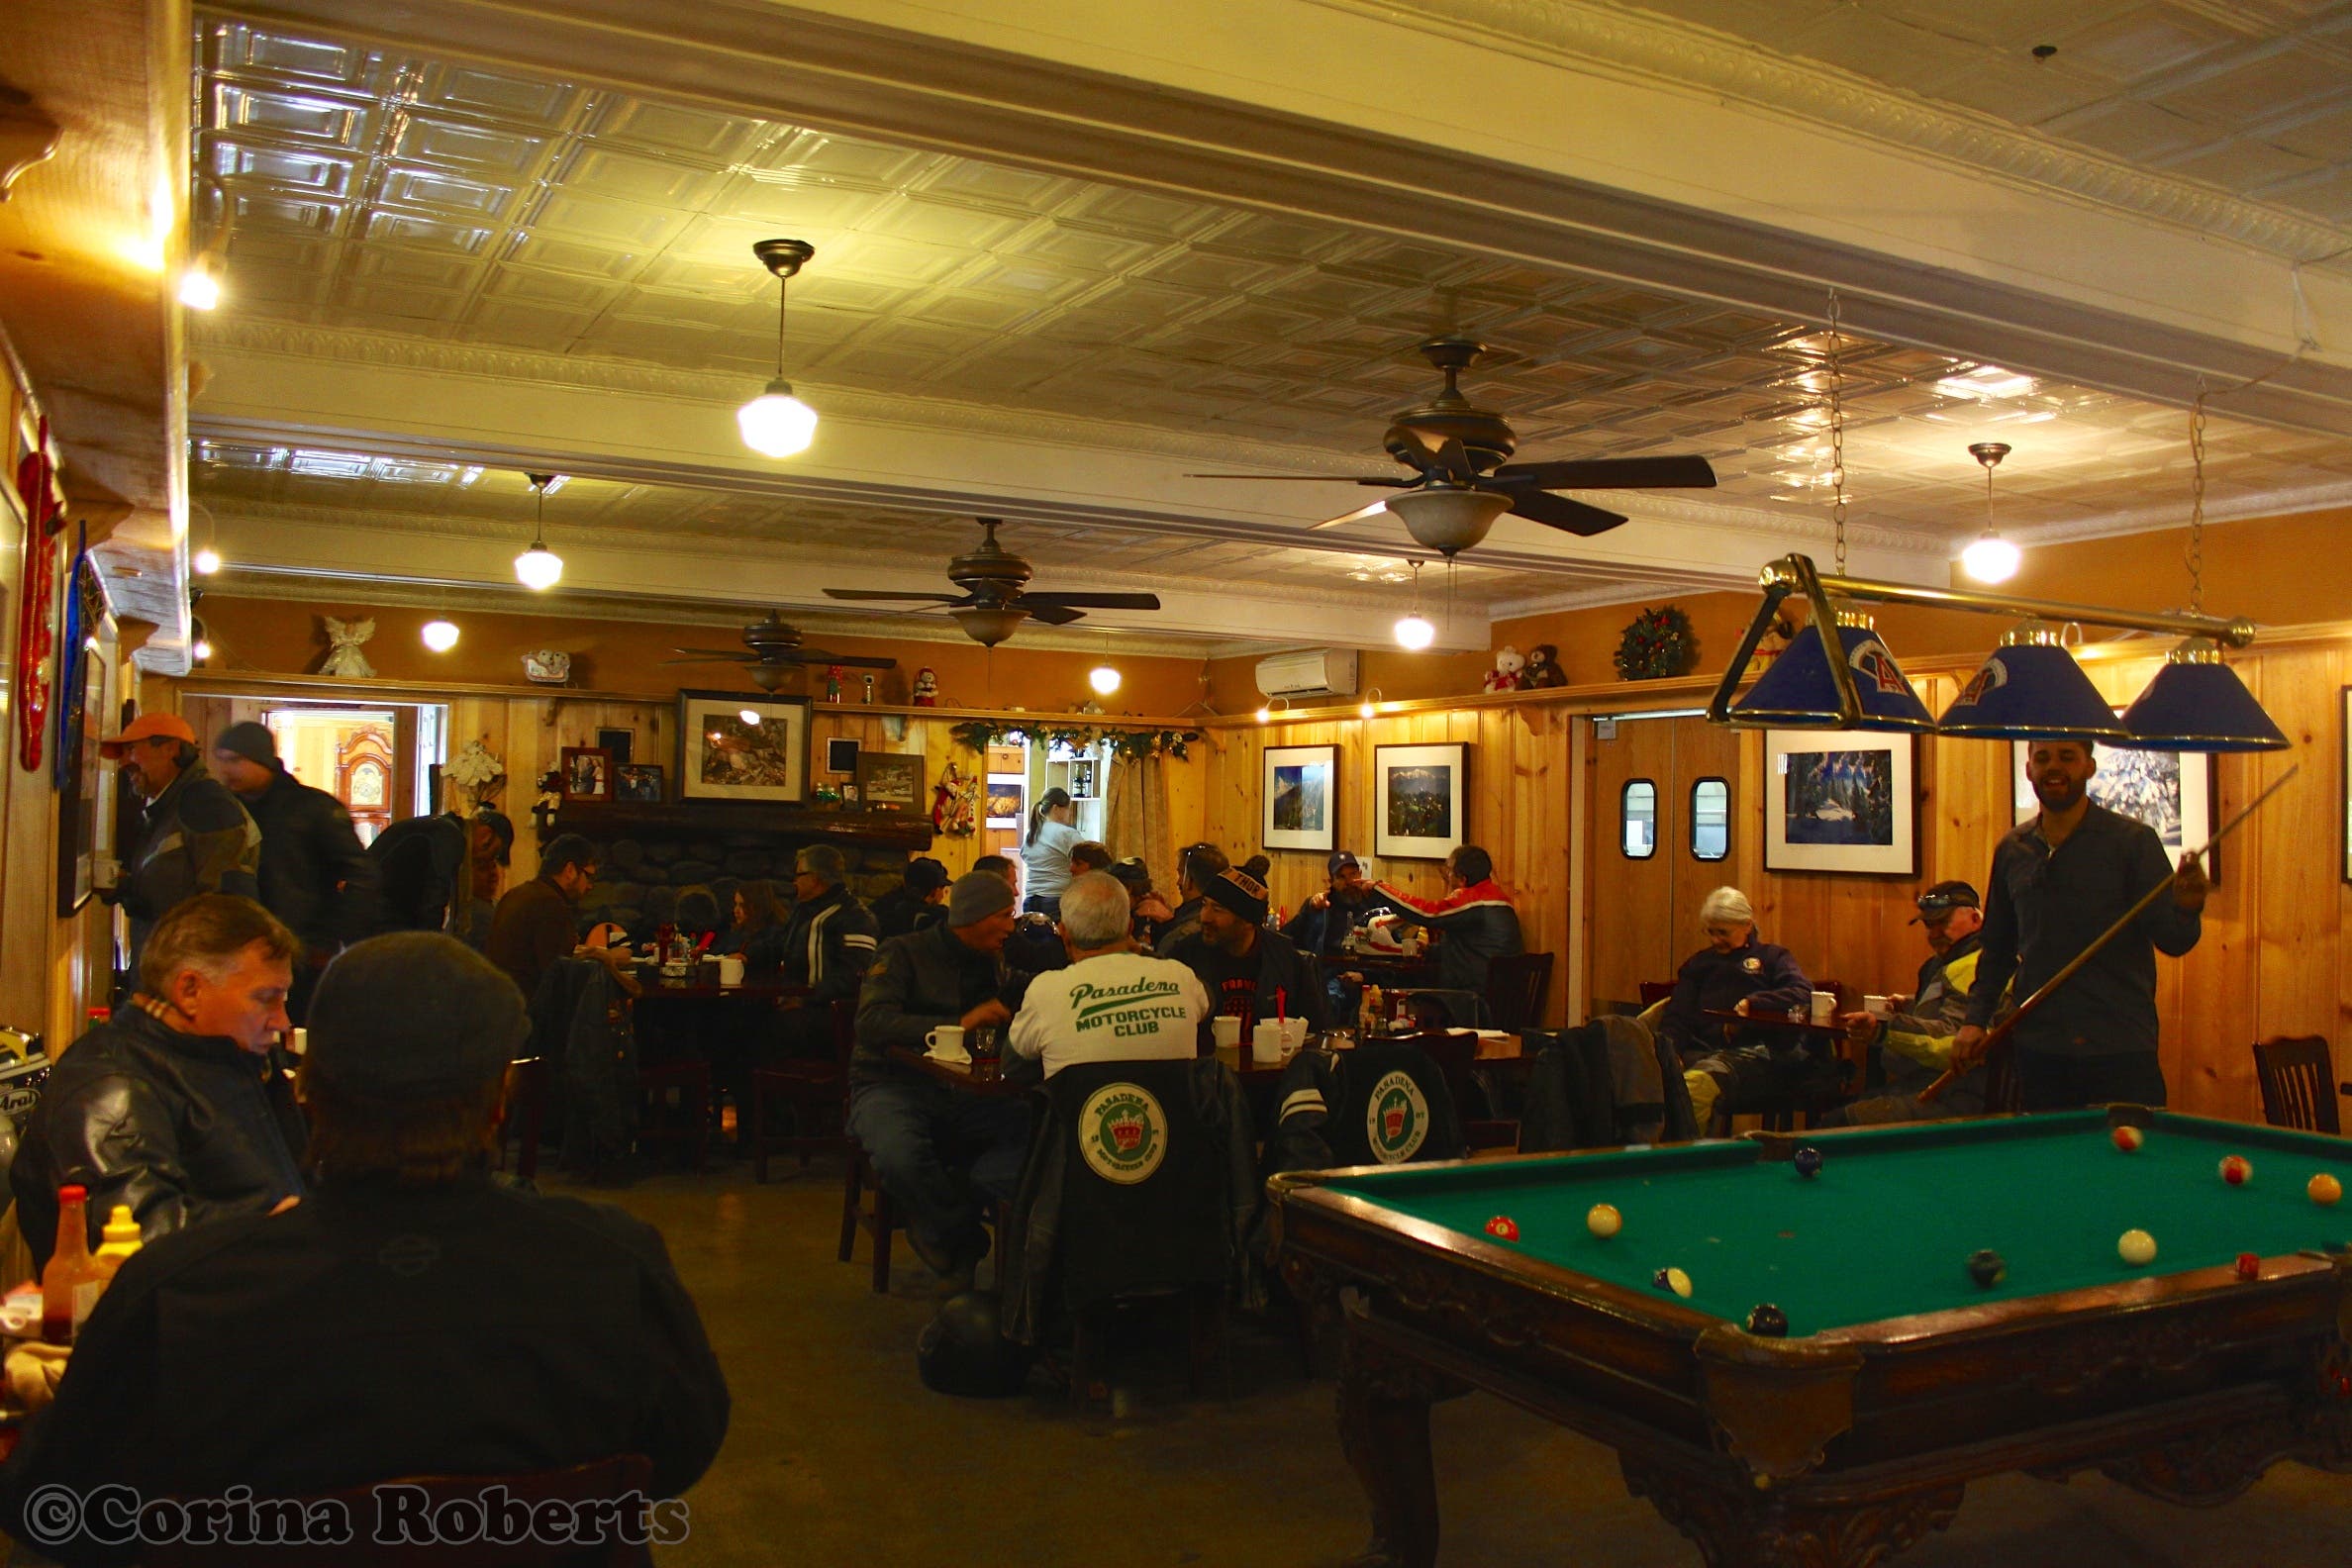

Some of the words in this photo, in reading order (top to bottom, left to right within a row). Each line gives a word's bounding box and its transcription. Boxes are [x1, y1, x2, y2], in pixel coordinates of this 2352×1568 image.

[1069, 976, 1179, 1009] Pasadena
[1075, 1007, 1187, 1032] MOTORCYCLE
[1114, 1021, 1160, 1037] CLUB
[1374, 1075, 1415, 1102] PASADENA
[1094, 1092, 1149, 1118] PASADENA
